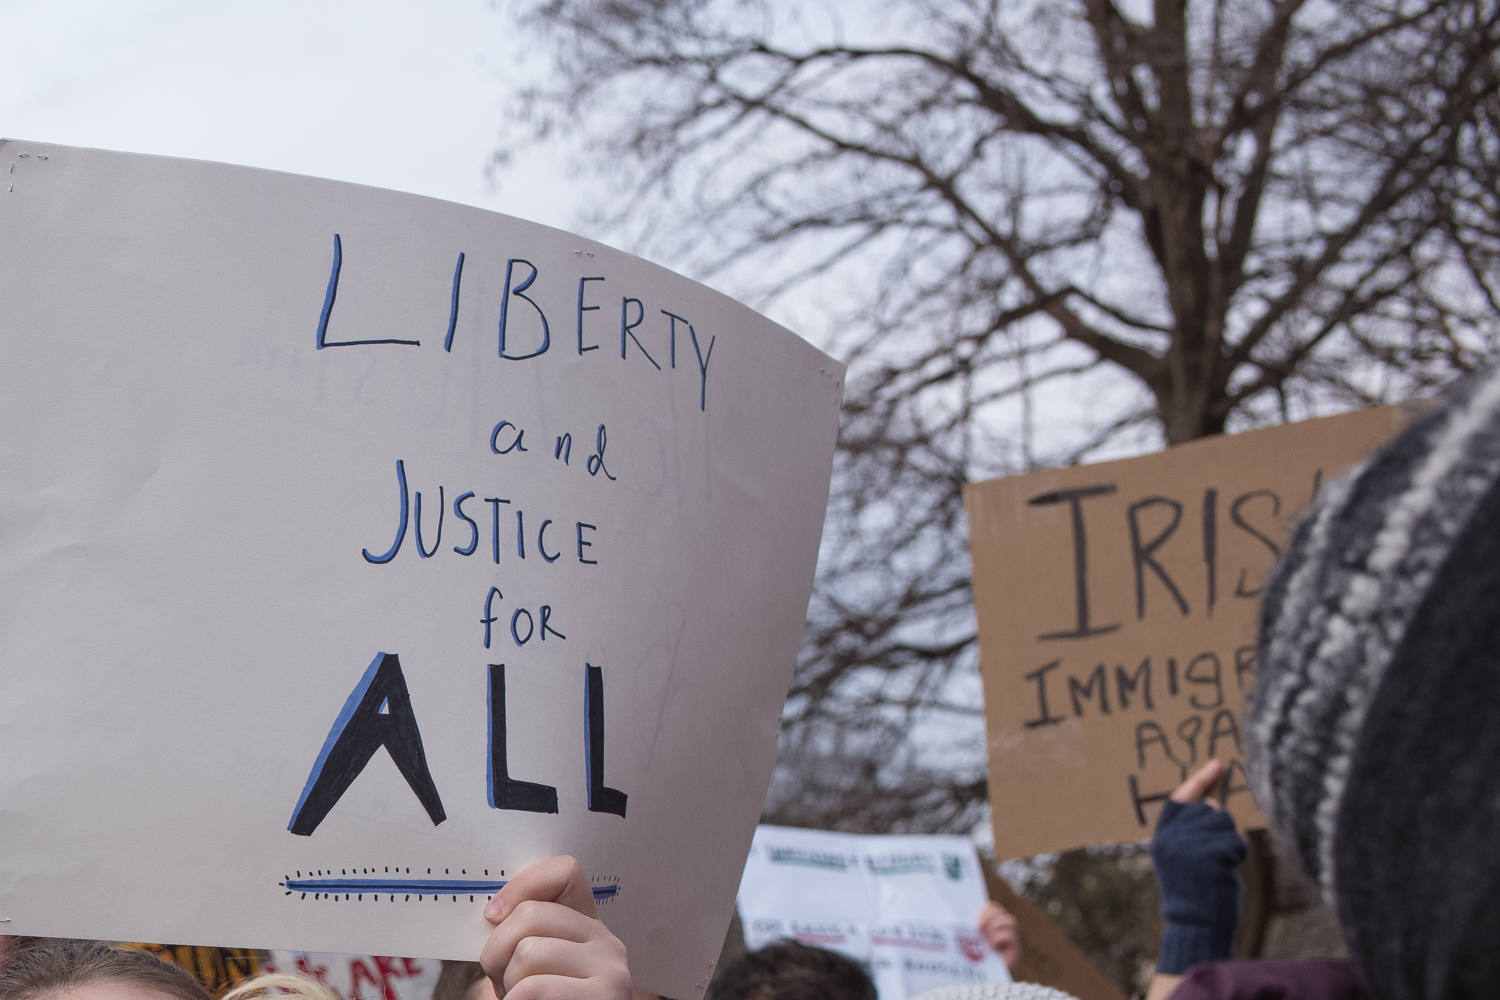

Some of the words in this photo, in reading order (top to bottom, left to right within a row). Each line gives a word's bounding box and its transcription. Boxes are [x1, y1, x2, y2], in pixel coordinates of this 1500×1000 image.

[316, 234, 716, 412] LIBERTY
[361, 460, 598, 565] JUSTICE
[489, 420, 617, 481] and
[1027, 468, 1323, 641] IRIS
[287, 652, 628, 837] ALL
